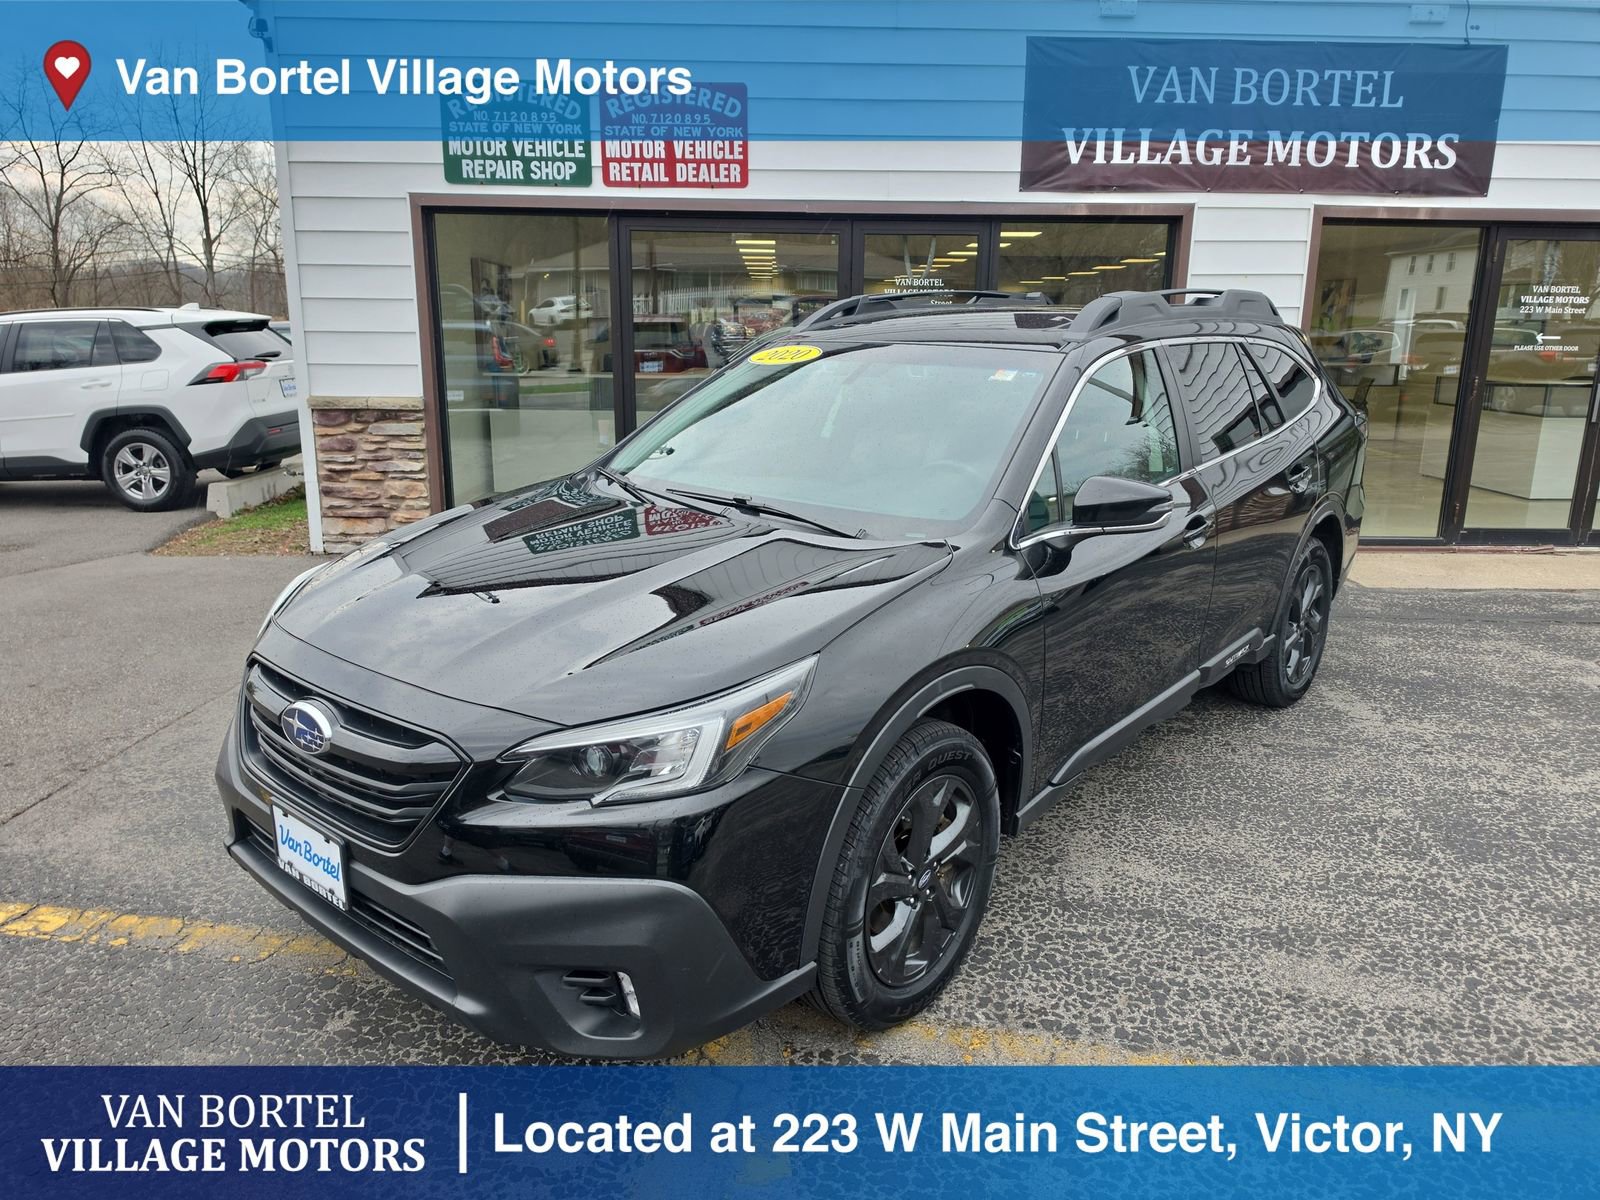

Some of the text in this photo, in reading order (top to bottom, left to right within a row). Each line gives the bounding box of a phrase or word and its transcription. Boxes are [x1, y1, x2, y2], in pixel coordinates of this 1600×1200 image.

[1128, 66, 1404, 108] VAN BORTEL
[447, 82, 582, 120] RITERED
[493, 111, 557, 123] 7120895
[651, 113, 711, 124] 7120895
[449, 121, 582, 135] STATE OF NEW YORK
[605, 125, 743, 138] STATE OF NEW YORK
[448, 136, 586, 158] MOTOR VEHICLE
[605, 139, 744, 160] MOTOR VEHICLE
[1061, 127, 1460, 170] VILLAGE MOTORS
[461, 159, 577, 181] REPAIR SHOP
[609, 162, 741, 183] RETAIL DEALER
[895, 278, 944, 287] VAN BORTEL
[1532, 285, 1581, 294] VAN BORTEL
[1520, 295, 1590, 304] VILLAGE MOTORS
[1520, 306, 1586, 314] 223 W Main Street
[757, 349, 812, 361] 2020
